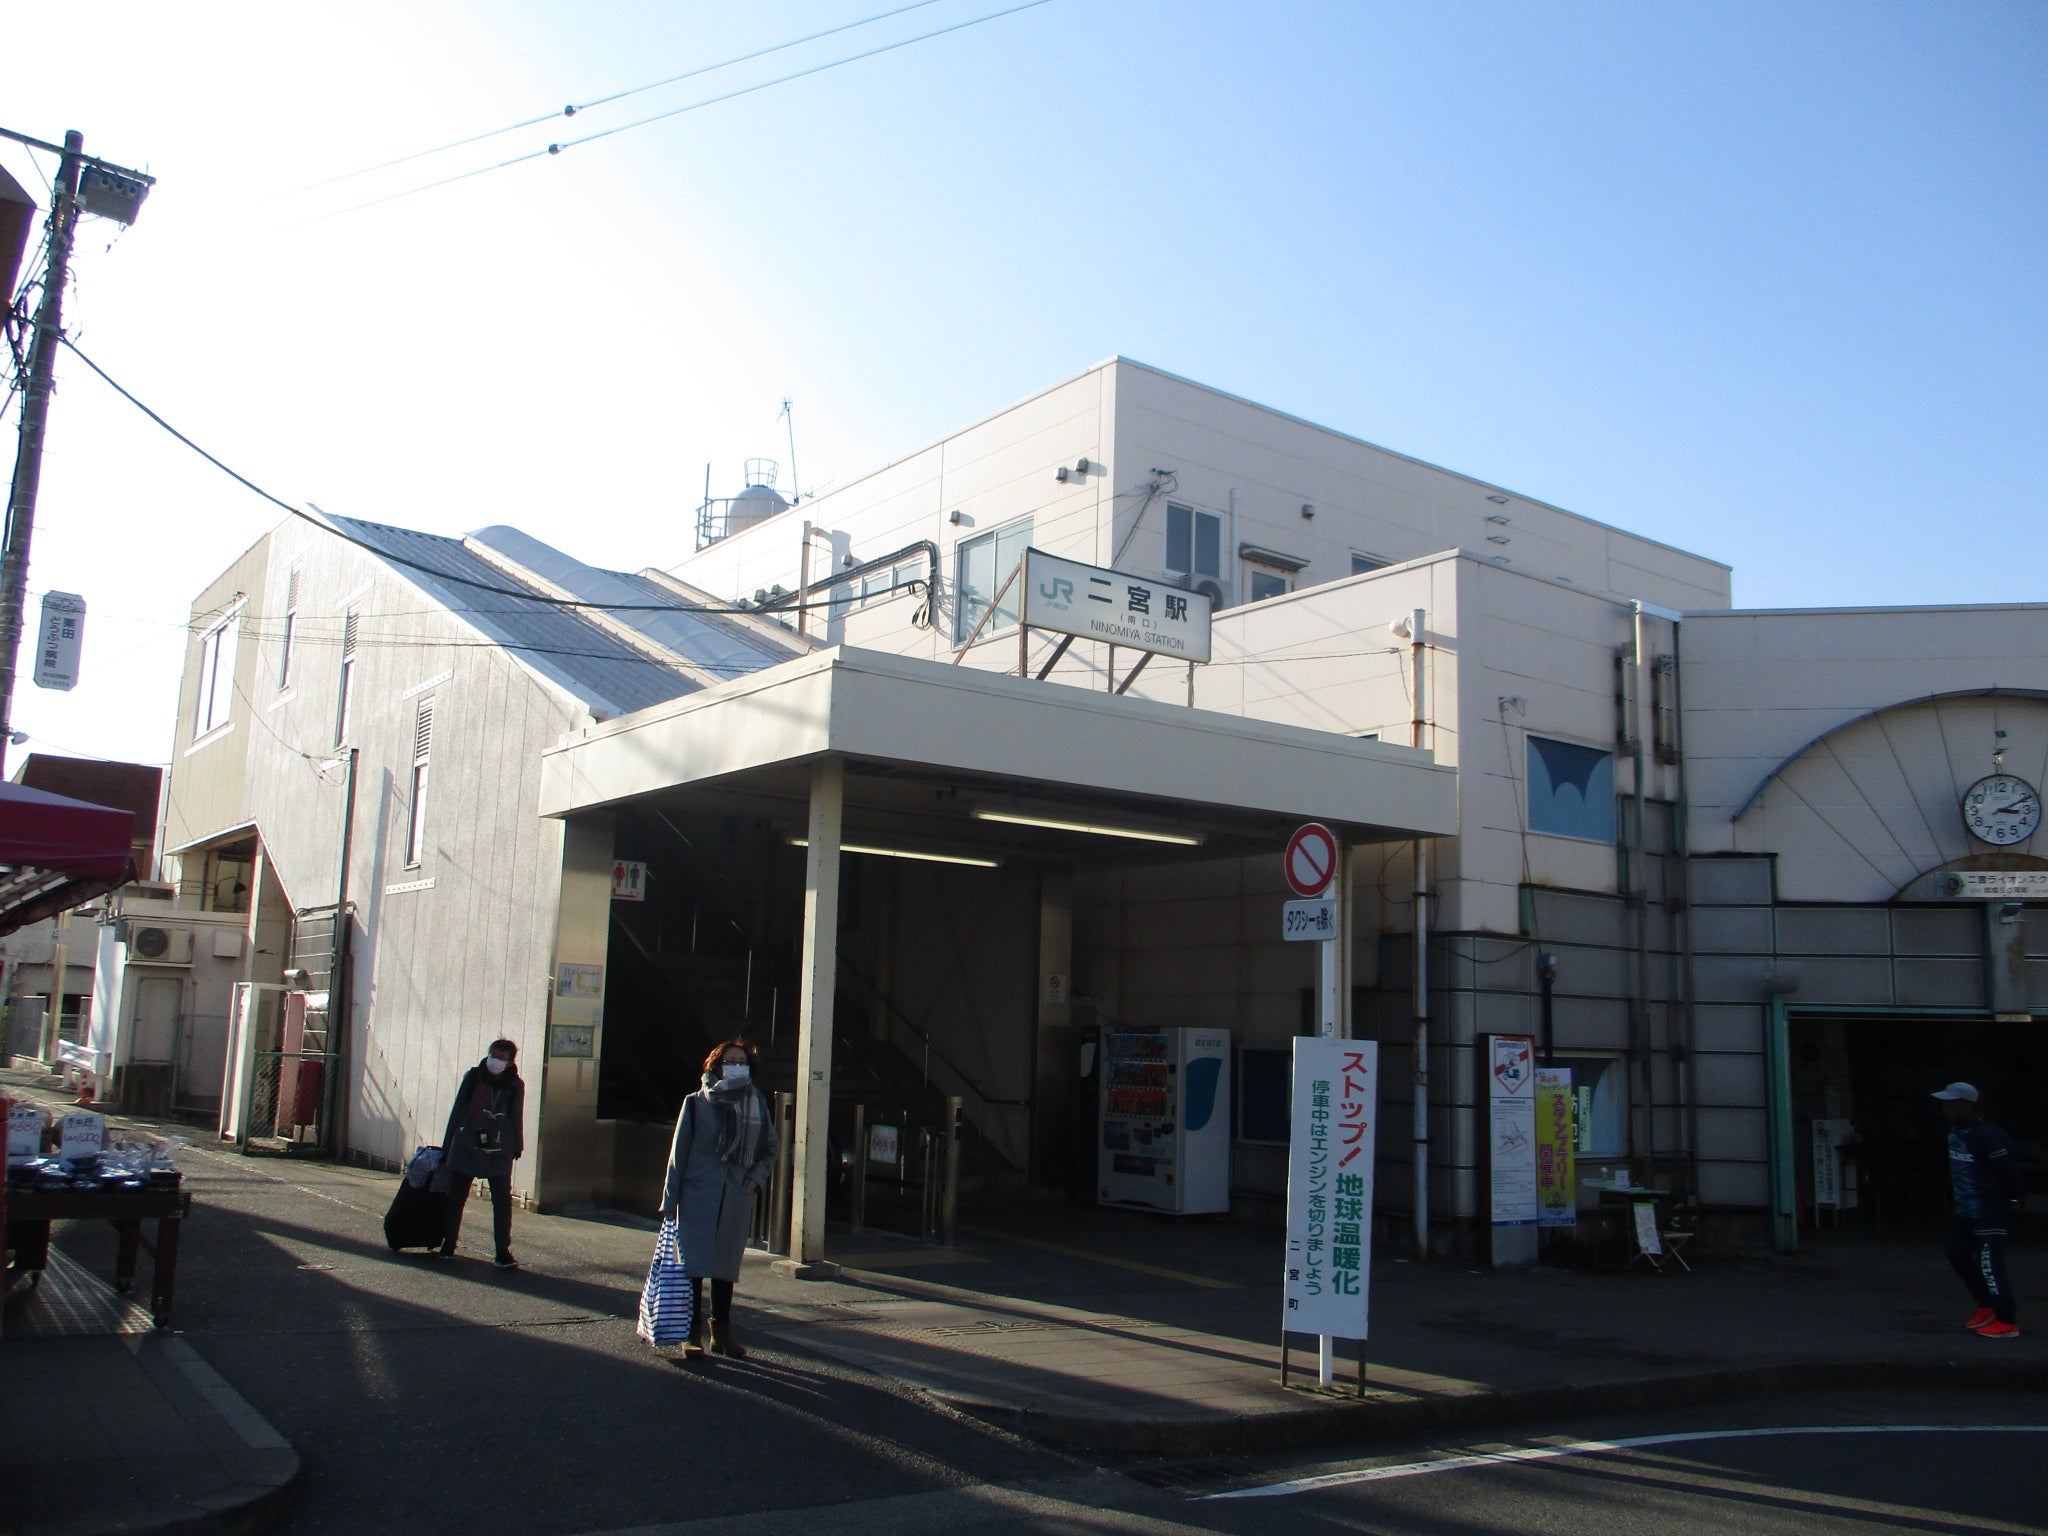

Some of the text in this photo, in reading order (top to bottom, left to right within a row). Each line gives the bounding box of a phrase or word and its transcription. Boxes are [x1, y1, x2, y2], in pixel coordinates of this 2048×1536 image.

[1040, 577, 1074, 604] JR
[1087, 576, 1188, 623] 二宮駅
[1090, 619, 1185, 650] NINOMIYA STATION
[1994, 782, 2006, 793] 12
[1970, 794, 1984, 804] 10
[1969, 805, 1978, 816] 9
[2022, 804, 2031, 815] 3
[1974, 816, 1983, 827] 8
[2018, 816, 2027, 826] 4
[1985, 825, 1993, 835] 7
[1996, 828, 2005, 839] 6
[2009, 825, 2018, 835] 5
[1286, 907, 1334, 932] タクシーを除く
[1304, 1079, 1331, 1296] 停車中はエンジンを切りましょう
[1287, 1239, 1300, 1311] 二宮町
